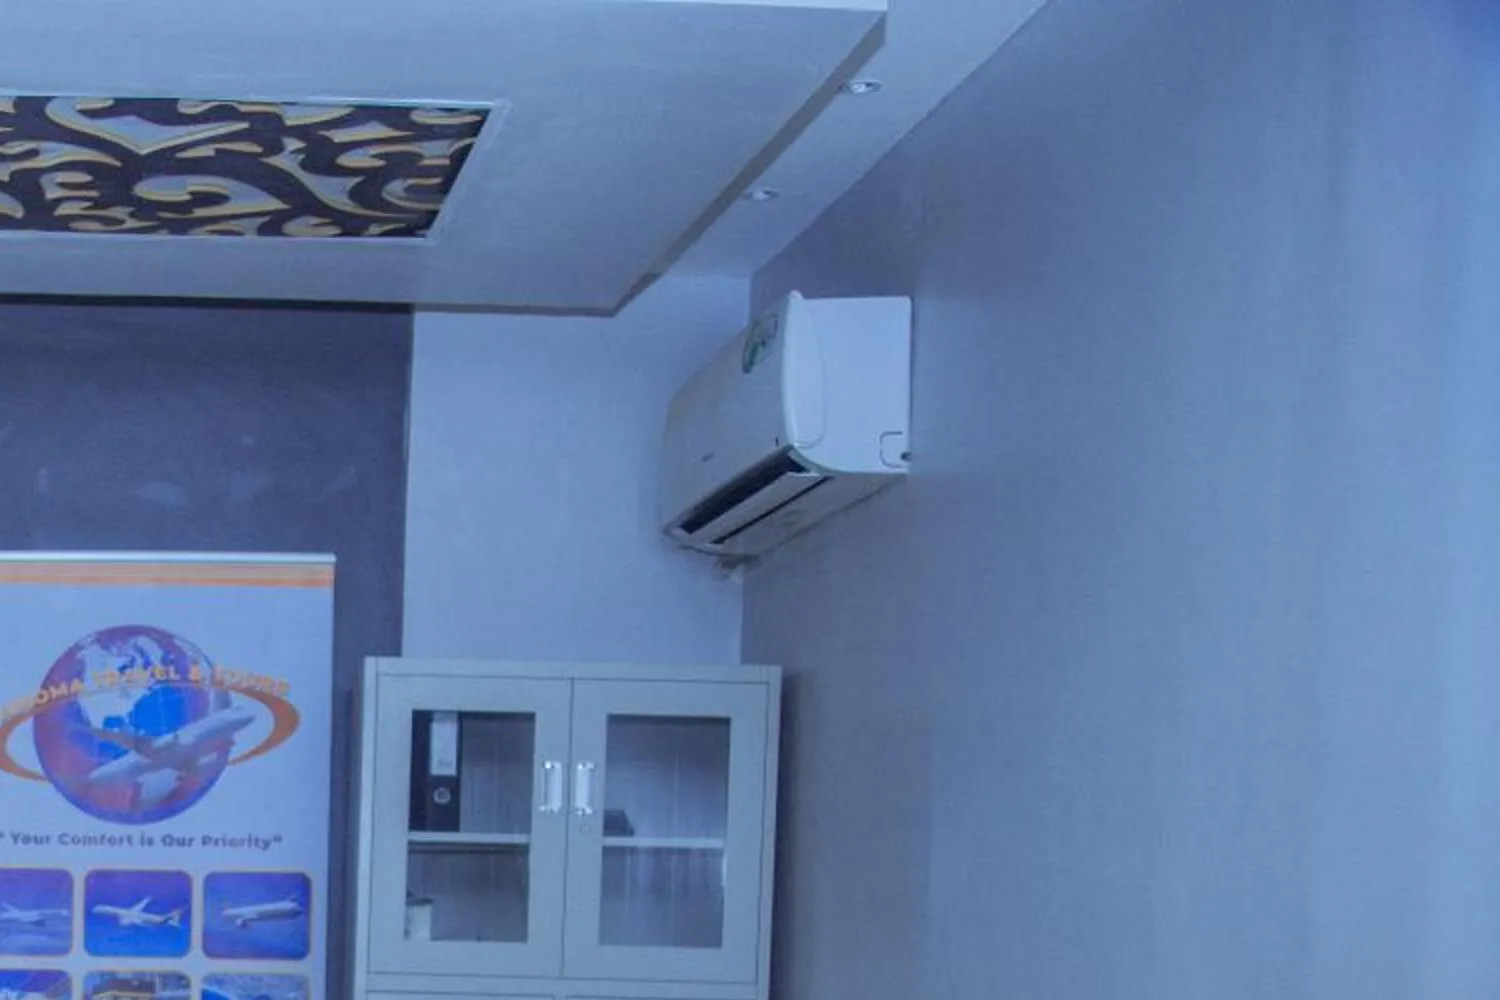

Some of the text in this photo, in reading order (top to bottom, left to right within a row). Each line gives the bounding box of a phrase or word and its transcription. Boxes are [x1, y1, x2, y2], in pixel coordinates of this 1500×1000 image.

[57, 832, 133, 847] Comfort
[140, 832, 154, 846] is
[161, 833, 195, 847] Our
